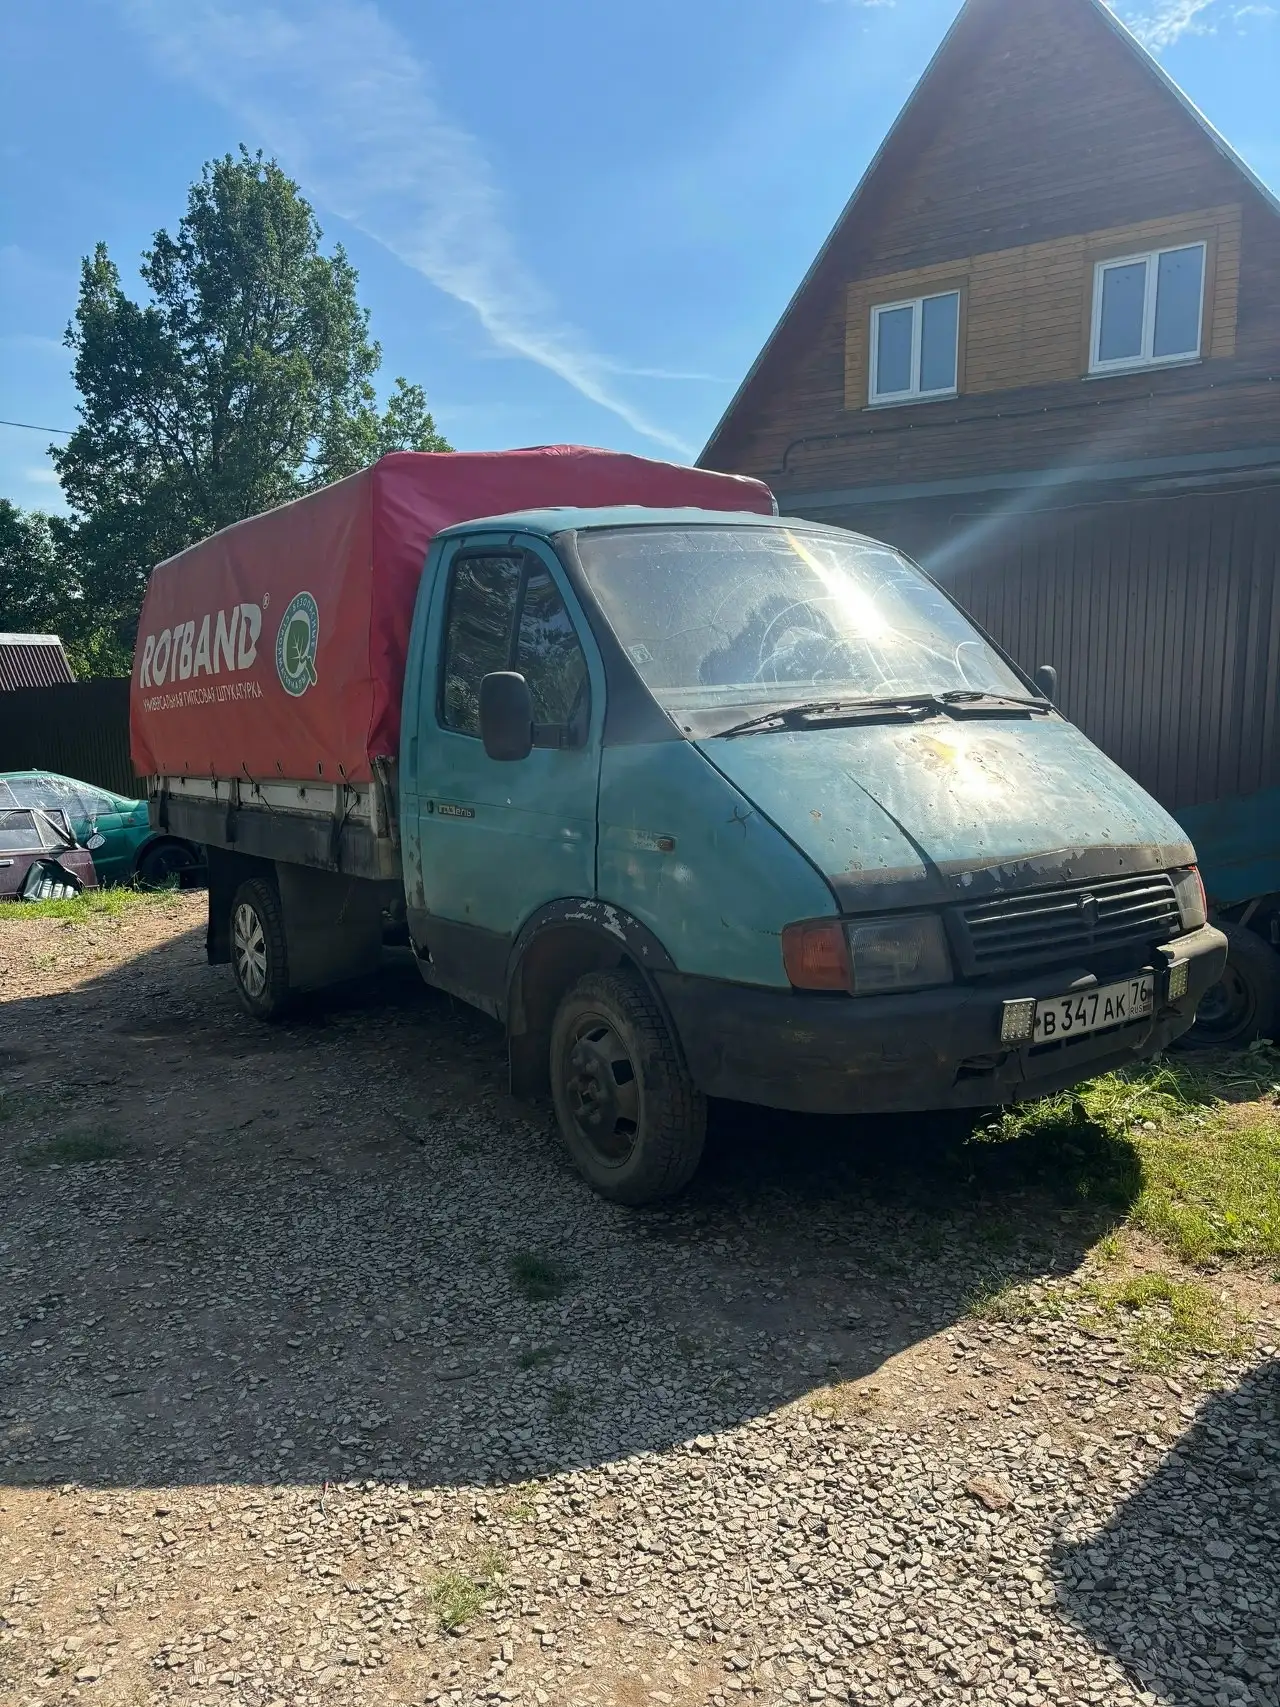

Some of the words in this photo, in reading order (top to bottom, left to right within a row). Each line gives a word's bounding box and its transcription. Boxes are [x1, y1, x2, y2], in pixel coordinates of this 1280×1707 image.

[183, 686, 215, 706] ГИПСОВАЯ
[216, 681, 264, 702] ШТУКАТУРКА
[1131, 980, 1148, 1005] 76
[1129, 1004, 1143, 1016] RUS
